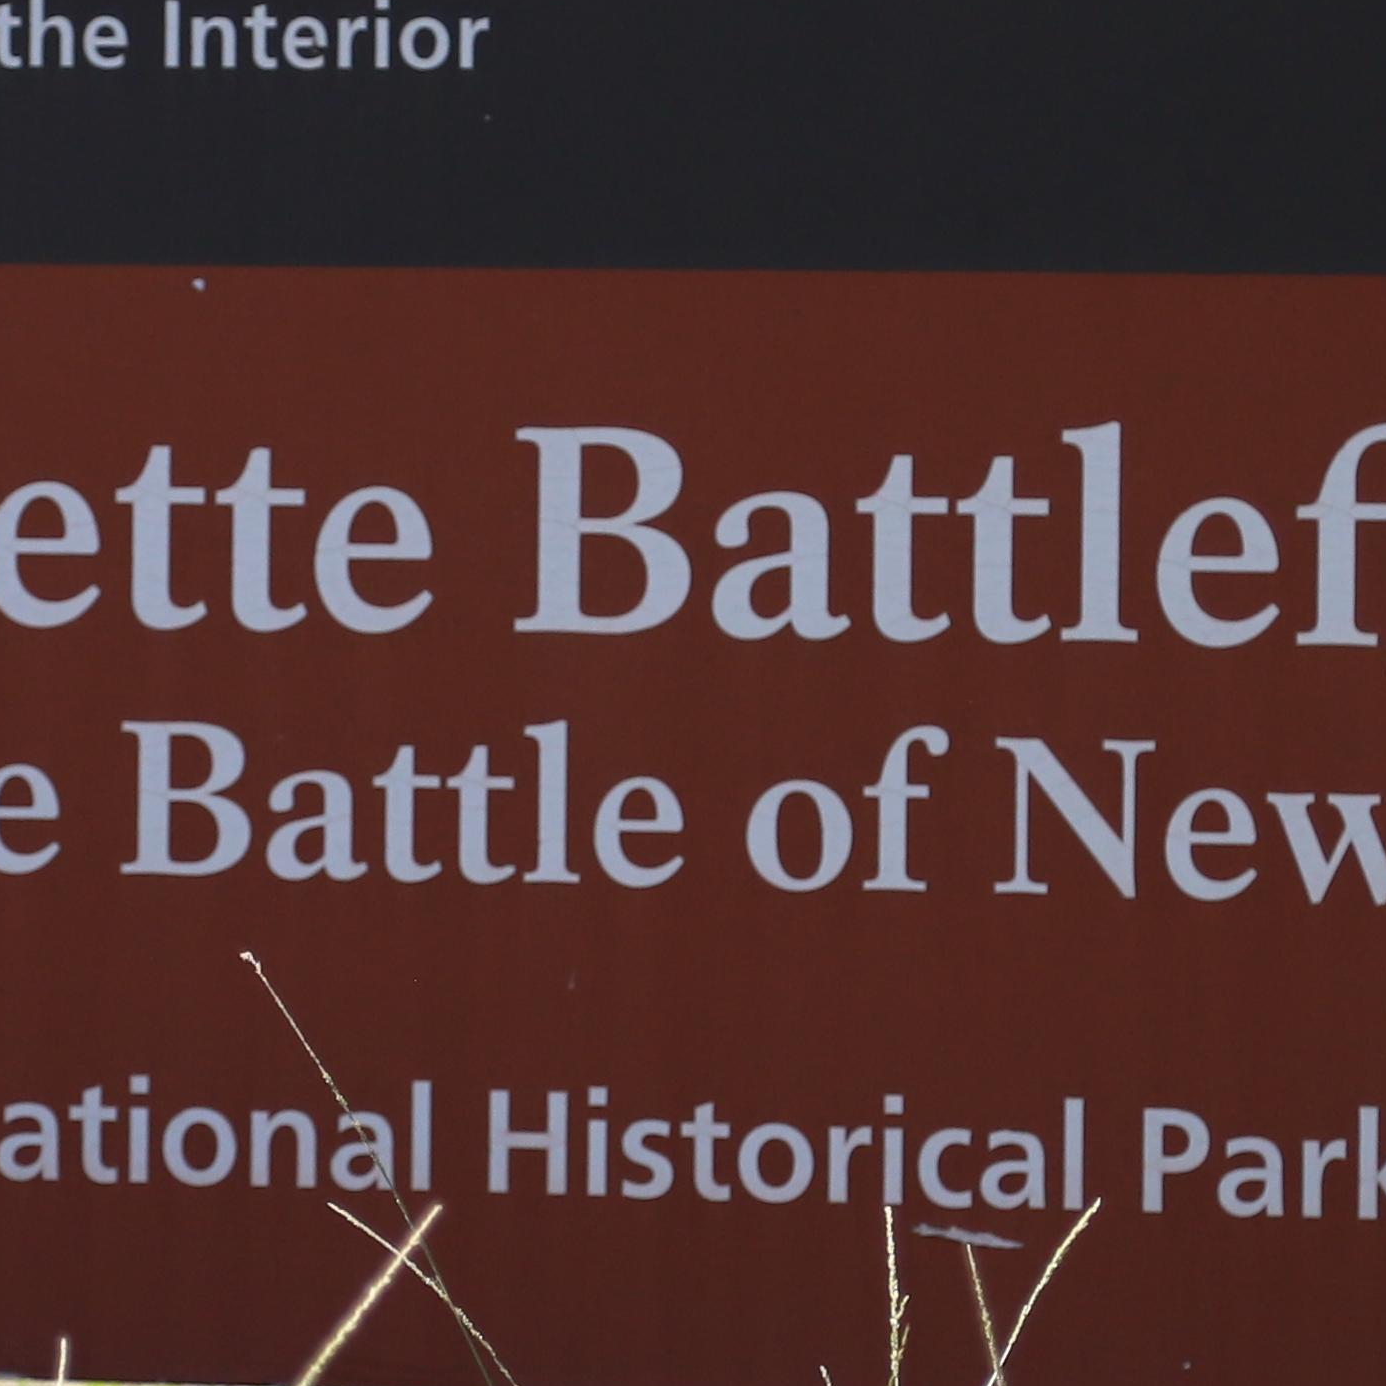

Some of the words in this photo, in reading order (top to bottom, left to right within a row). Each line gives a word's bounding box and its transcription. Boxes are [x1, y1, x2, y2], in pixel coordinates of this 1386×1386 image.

[165, 0, 490, 70] Interior
[120, 721, 684, 888] Battle
[746, 725, 949, 893] of
[489, 1086, 1084, 1212] Historical
